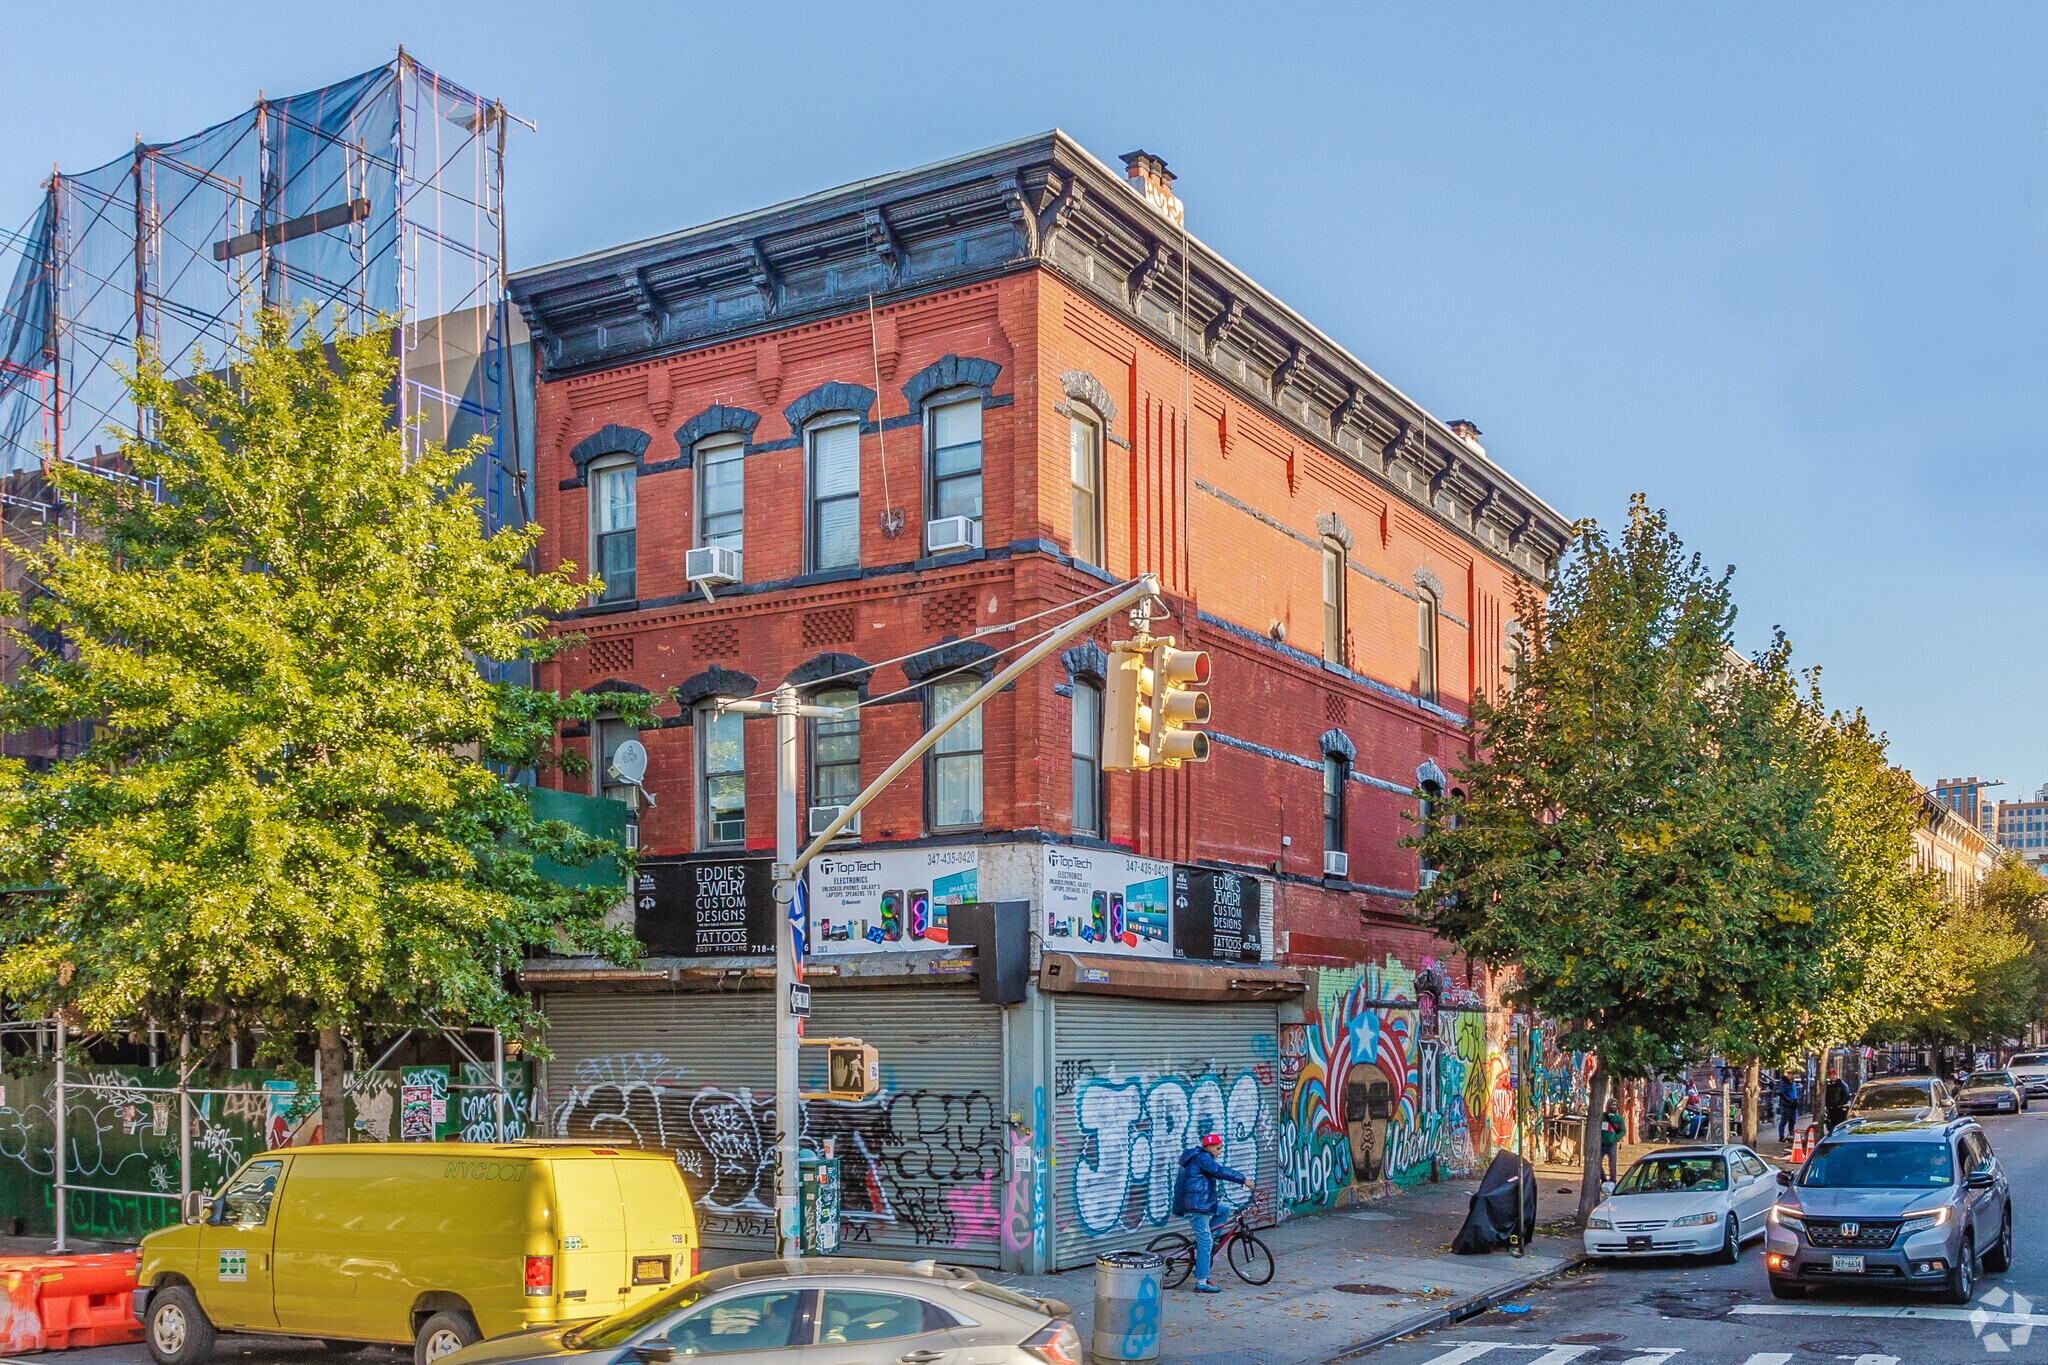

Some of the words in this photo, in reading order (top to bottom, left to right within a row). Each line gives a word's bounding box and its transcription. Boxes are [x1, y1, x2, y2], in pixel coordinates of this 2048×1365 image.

[927, 851, 976, 866] 347-435-0420
[1059, 854, 1092, 870] TopTech
[696, 865, 745, 881] EDDIE'S
[835, 860, 882, 874] TopTech
[1126, 859, 1169, 877] 347-435-0420
[833, 876, 868, 885] ELECTRONICS
[1058, 870, 1083, 881] ELECTRONICS
[696, 880, 745, 897] JEWELRY
[949, 884, 968, 893] SMART
[696, 896, 746, 910] CUSTOM
[1213, 889, 1241, 906] JEWELRY
[696, 909, 746, 922] DESIGNS
[1213, 904, 1242, 918] CUSTOM
[1213, 916, 1241, 930] DESIGNS
[696, 931, 747, 943] TATTOOS
[1213, 936, 1241, 950] TATTOOS
[817, 945, 828, 953] 383
[220, 1257, 246, 1274] DOT
